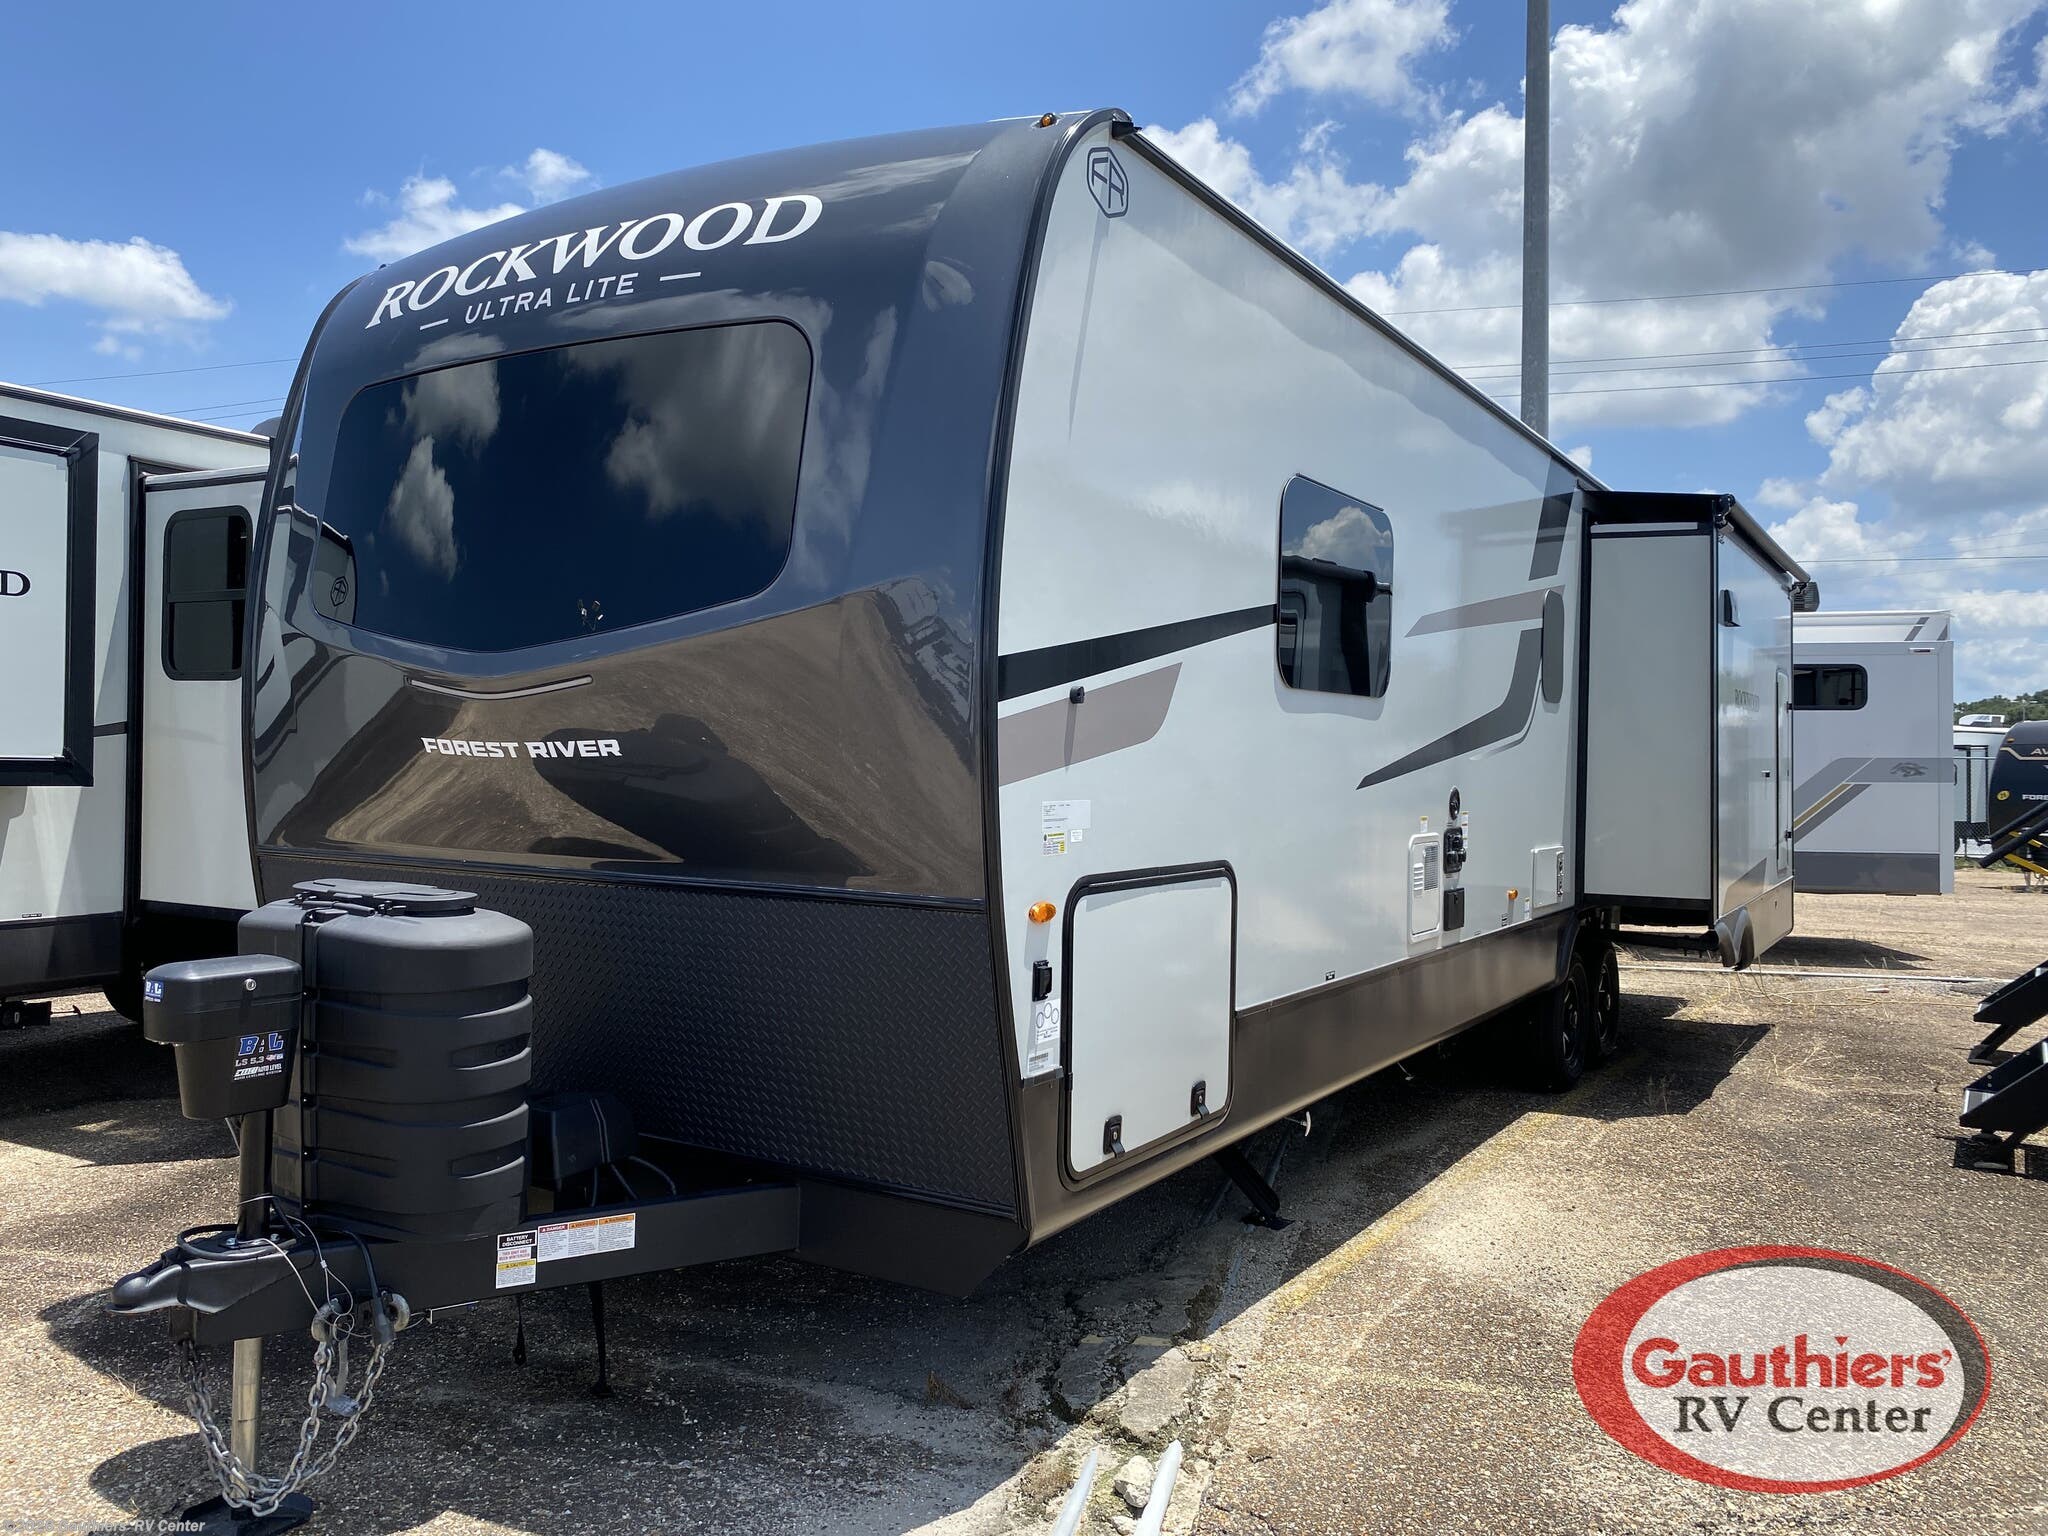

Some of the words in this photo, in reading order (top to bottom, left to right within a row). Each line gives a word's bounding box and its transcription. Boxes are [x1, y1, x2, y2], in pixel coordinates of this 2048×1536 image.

[365, 194, 824, 329] ROCKWOOD
[465, 288, 553, 324] ULTRA
[566, 273, 639, 304] LITE
[420, 737, 519, 758] FOREST
[524, 739, 623, 758] RIVER
[235, 1059, 248, 1067] LS
[250, 1056, 265, 1065] 5.3
[502, 1239, 533, 1247] DISCONNECT
